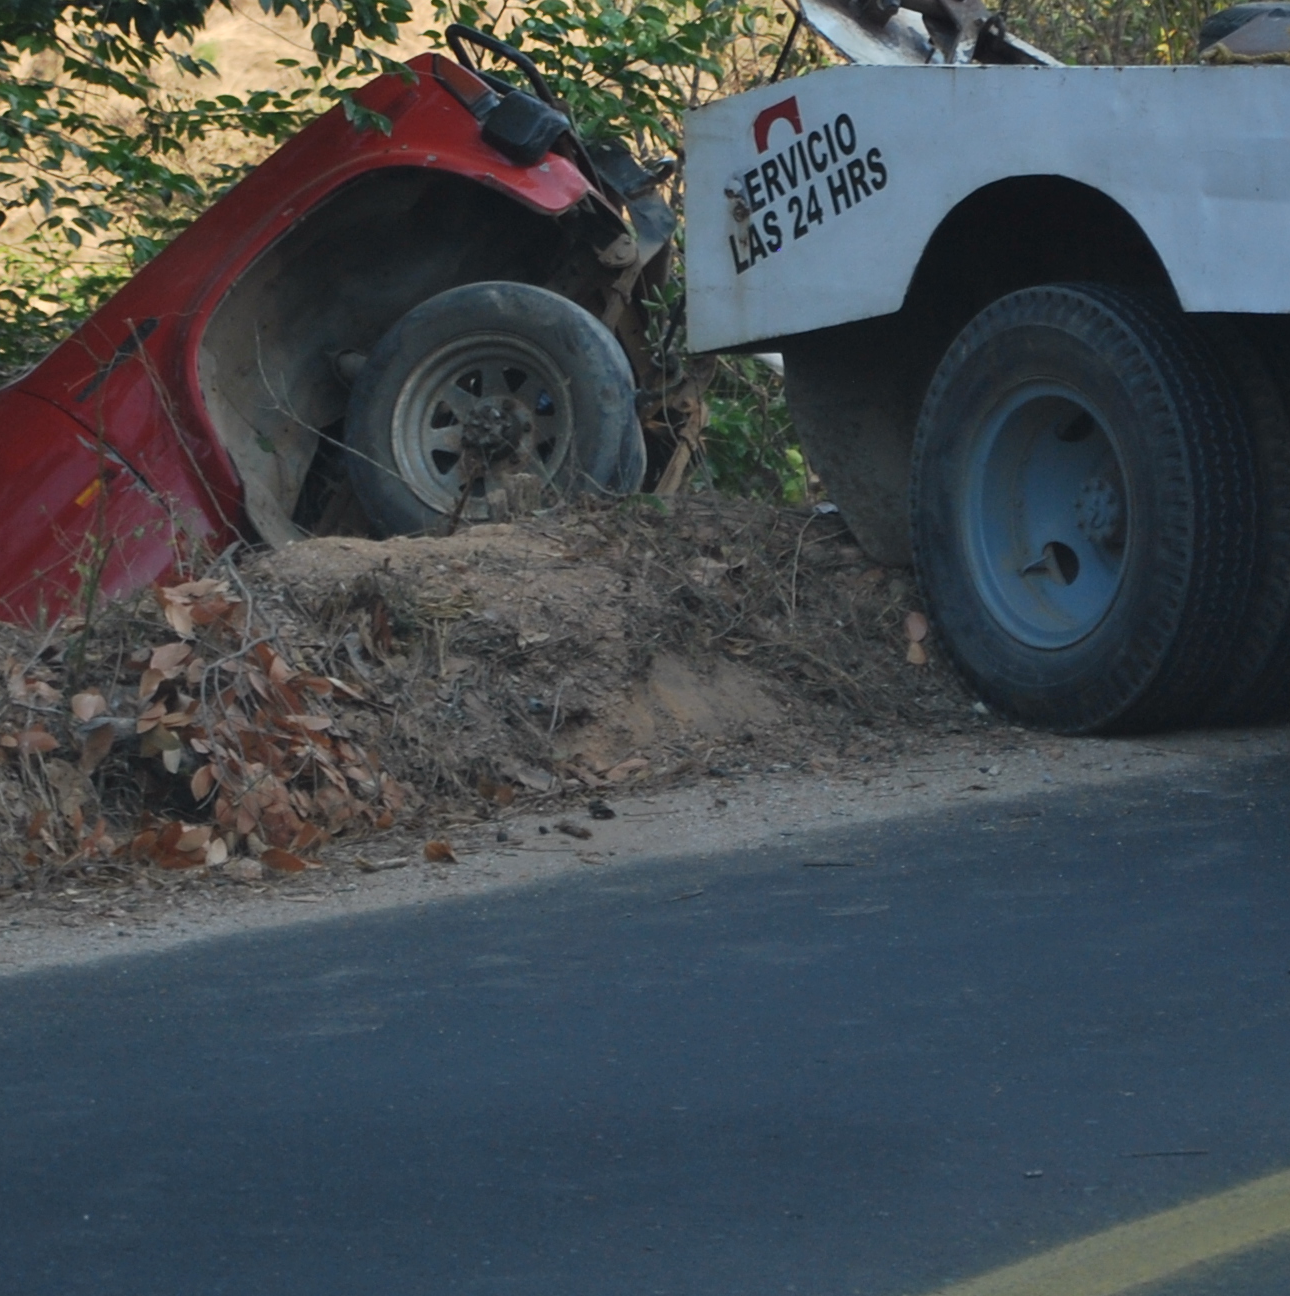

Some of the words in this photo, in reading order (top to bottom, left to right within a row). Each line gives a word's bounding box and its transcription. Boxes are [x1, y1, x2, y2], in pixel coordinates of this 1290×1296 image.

[729, 210, 783, 275] LAS
[787, 184, 824, 241] 24
[826, 146, 888, 216] HRS
[731, 112, 857, 215] ERVICIO
